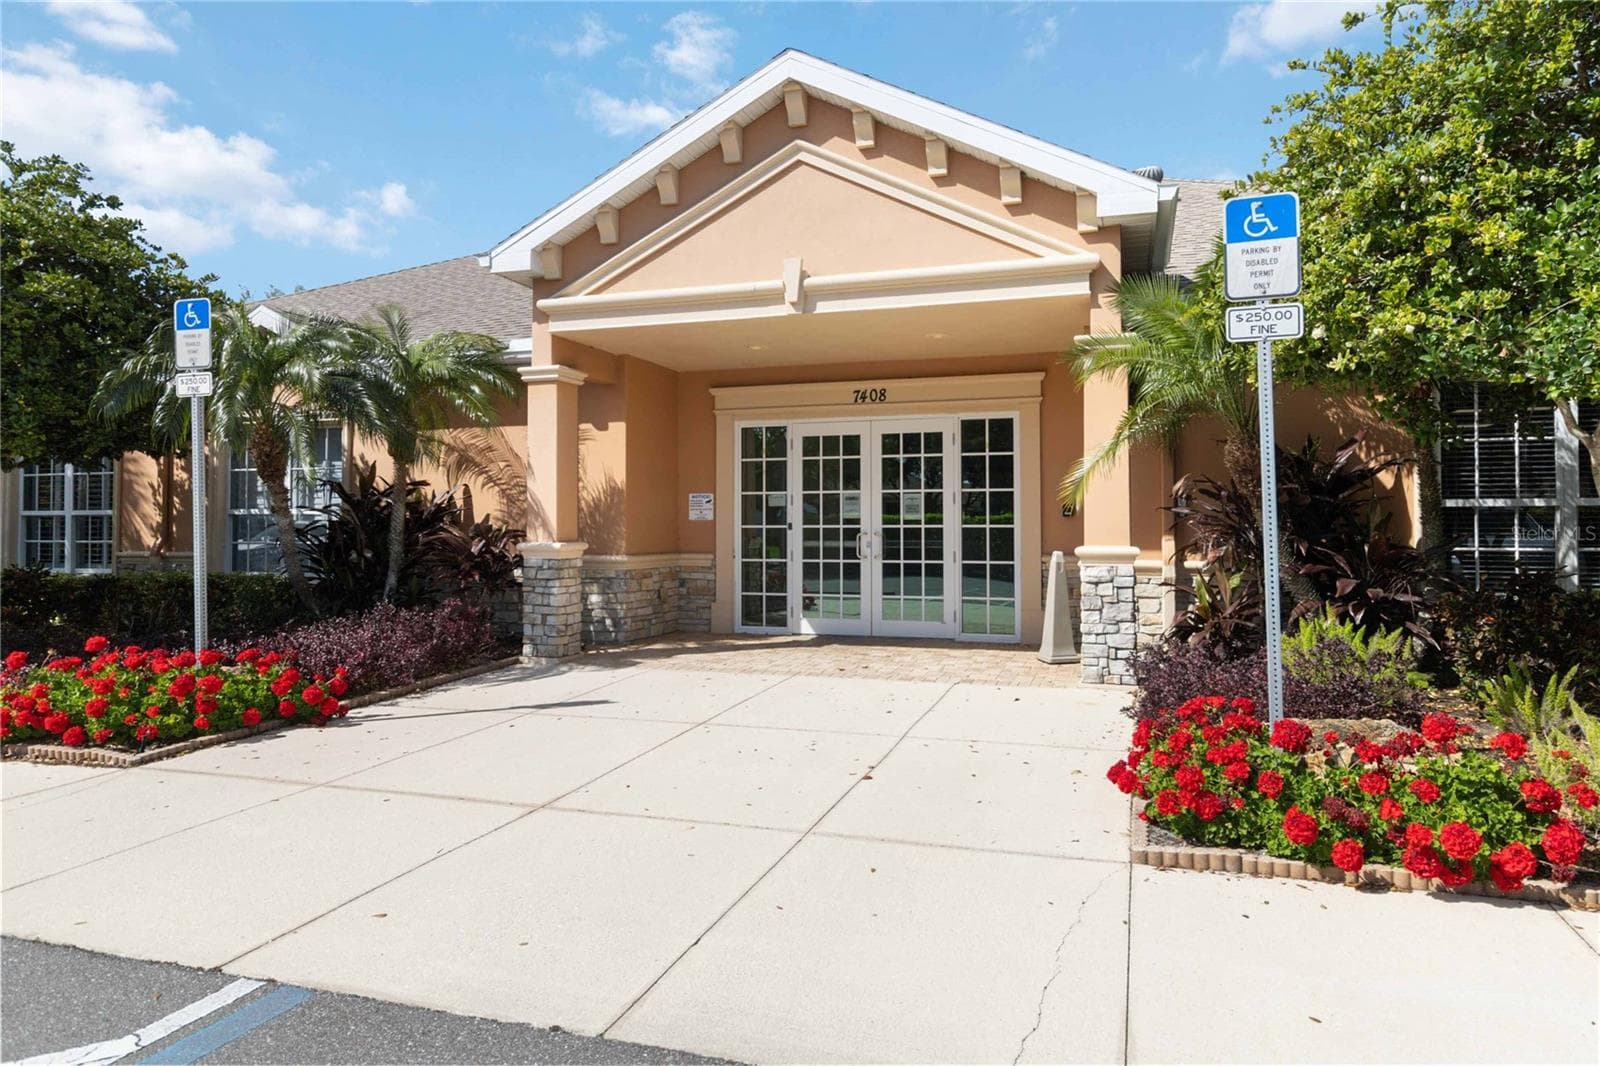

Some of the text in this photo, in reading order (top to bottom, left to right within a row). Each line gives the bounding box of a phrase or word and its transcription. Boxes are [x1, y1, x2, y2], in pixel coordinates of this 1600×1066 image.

[1241, 246, 1270, 255] PARKING
[1245, 257, 1279, 267] DISABLED
[1249, 269, 1274, 278] PERMIT
[1235, 310, 1293, 323] $250.00
[1250, 324, 1278, 335] FINE
[852, 388, 888, 403] 7408
